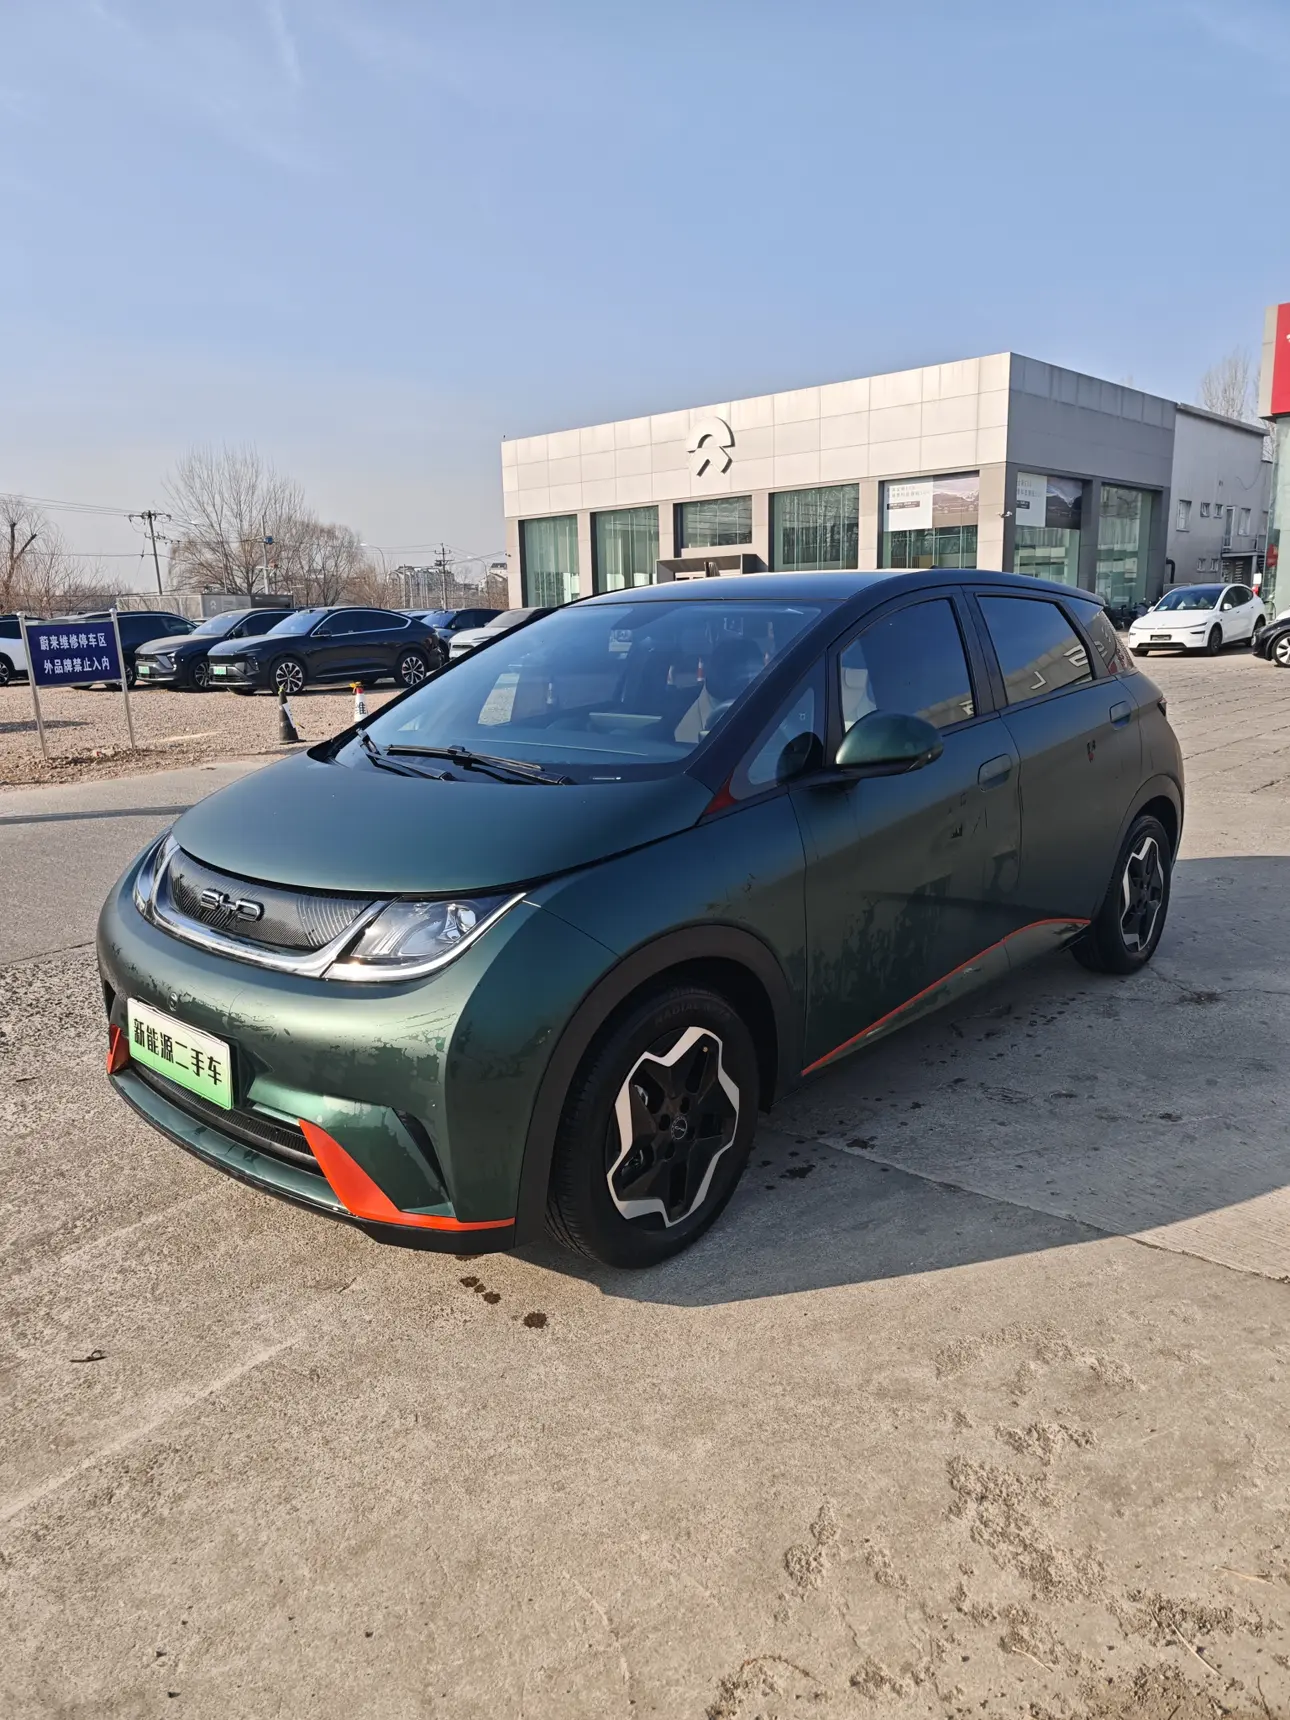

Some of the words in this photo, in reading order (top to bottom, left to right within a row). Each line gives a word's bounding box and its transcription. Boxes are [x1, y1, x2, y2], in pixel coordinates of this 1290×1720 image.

[39, 632, 107, 651] 蔚来维修停车区
[43, 655, 110, 675] 外品牌禁止入内
[200, 887, 265, 922] BYD
[133, 1017, 222, 1086] 新能源二手车
